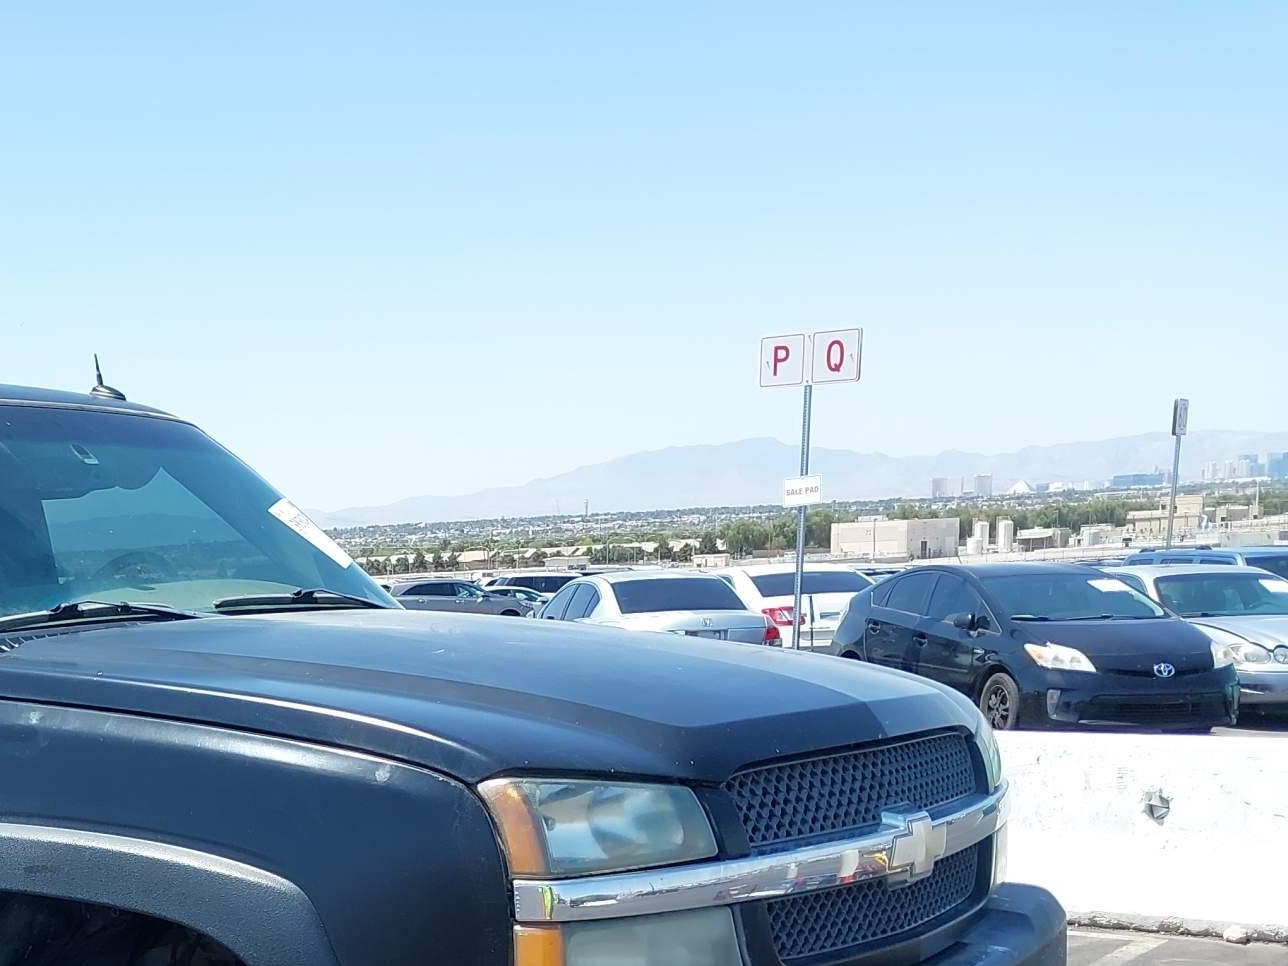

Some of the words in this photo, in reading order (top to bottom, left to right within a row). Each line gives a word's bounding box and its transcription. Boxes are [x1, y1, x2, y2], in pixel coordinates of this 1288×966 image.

[772, 345, 790, 377] P
[825, 339, 845, 373] Q
[786, 487, 804, 497] SALE
